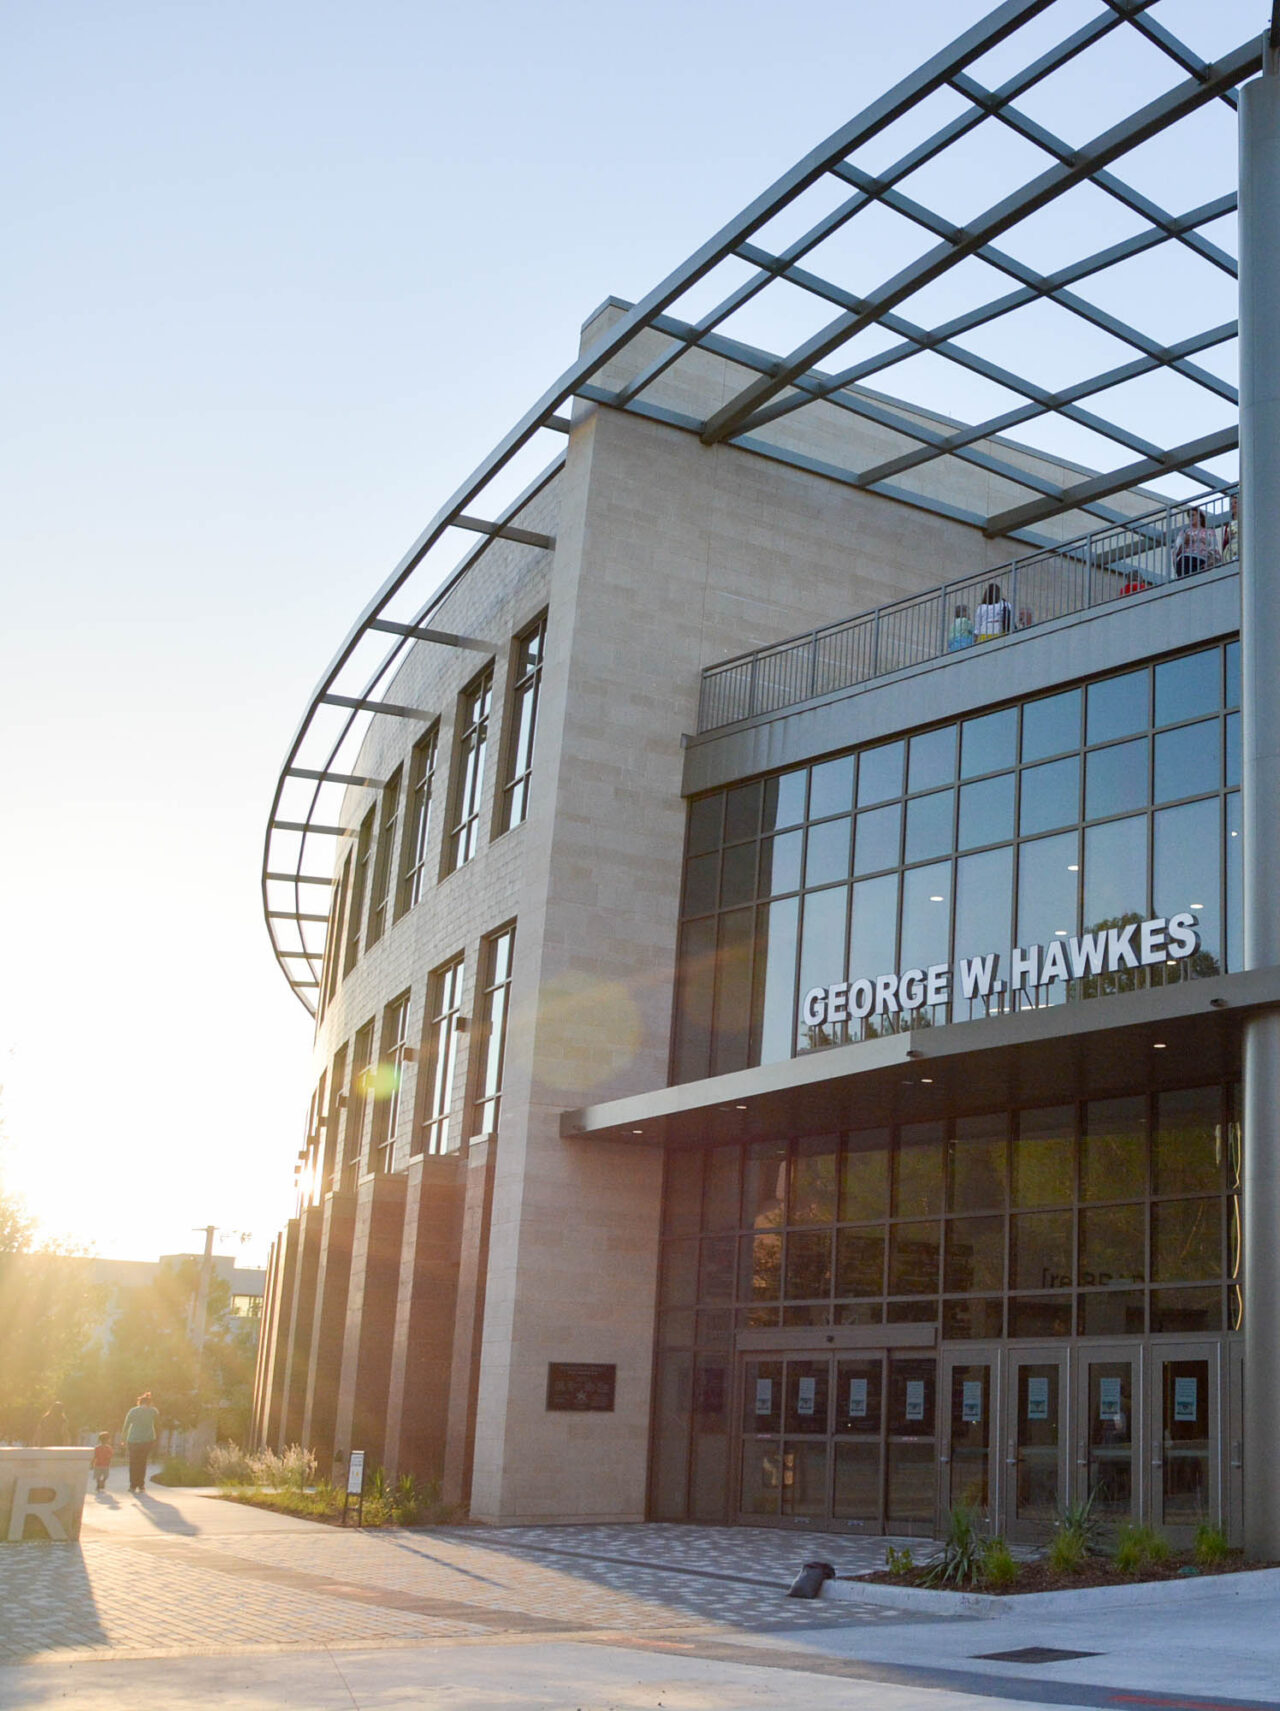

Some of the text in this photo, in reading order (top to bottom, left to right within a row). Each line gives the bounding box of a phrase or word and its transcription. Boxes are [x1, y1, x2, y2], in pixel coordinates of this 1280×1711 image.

[803, 912, 1199, 1026] GEORGE W. HAWKES
